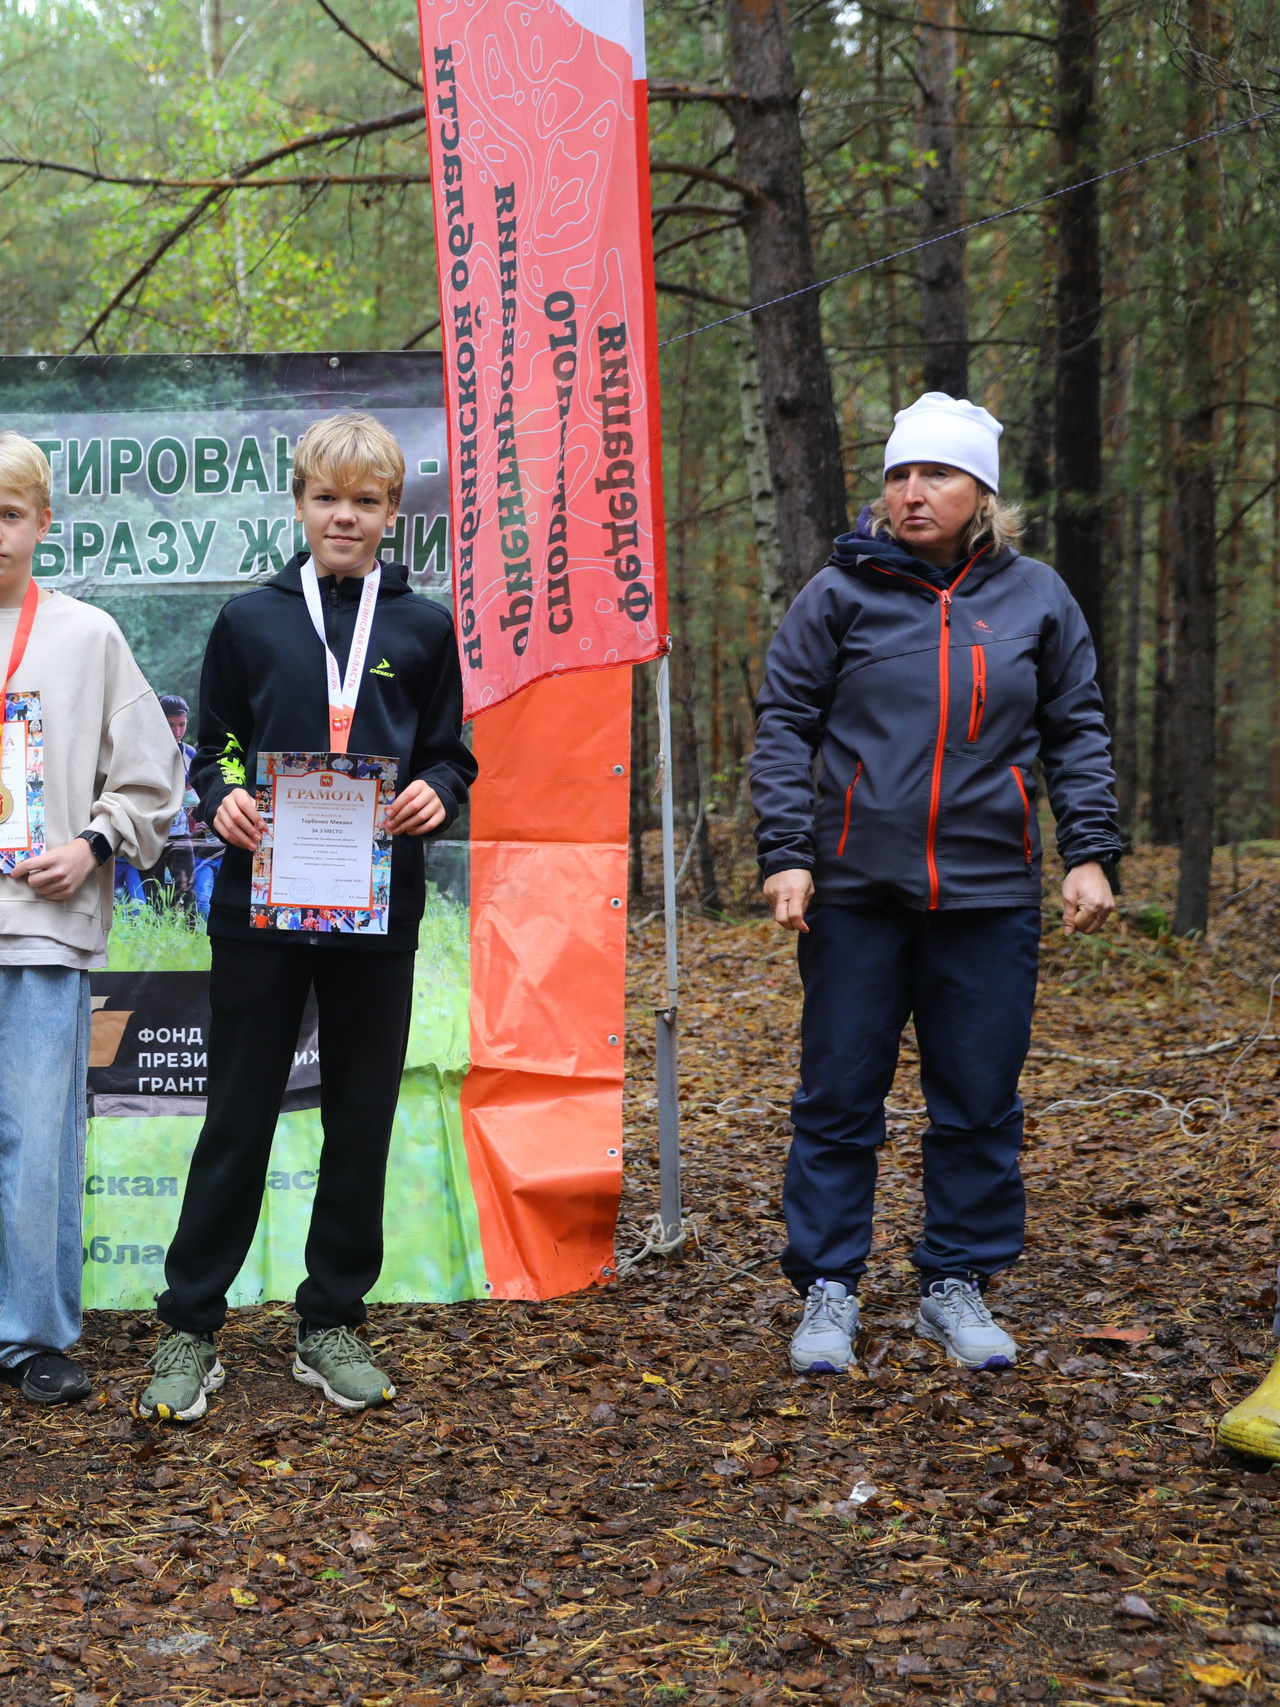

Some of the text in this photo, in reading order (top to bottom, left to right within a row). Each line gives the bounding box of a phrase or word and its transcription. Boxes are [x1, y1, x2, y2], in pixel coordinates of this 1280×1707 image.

[30, 518, 218, 579] БРАЗУ
[348, 581, 376, 689] ЧЕЛЯБИНСКАЯ ОБЛАСТЬ
[369, 668, 395, 678] DEMIX
[286, 787, 365, 802] ГРАМОТА
[138, 1027, 203, 1045] ФОНД
[138, 1077, 207, 1092] ГРАНТ
